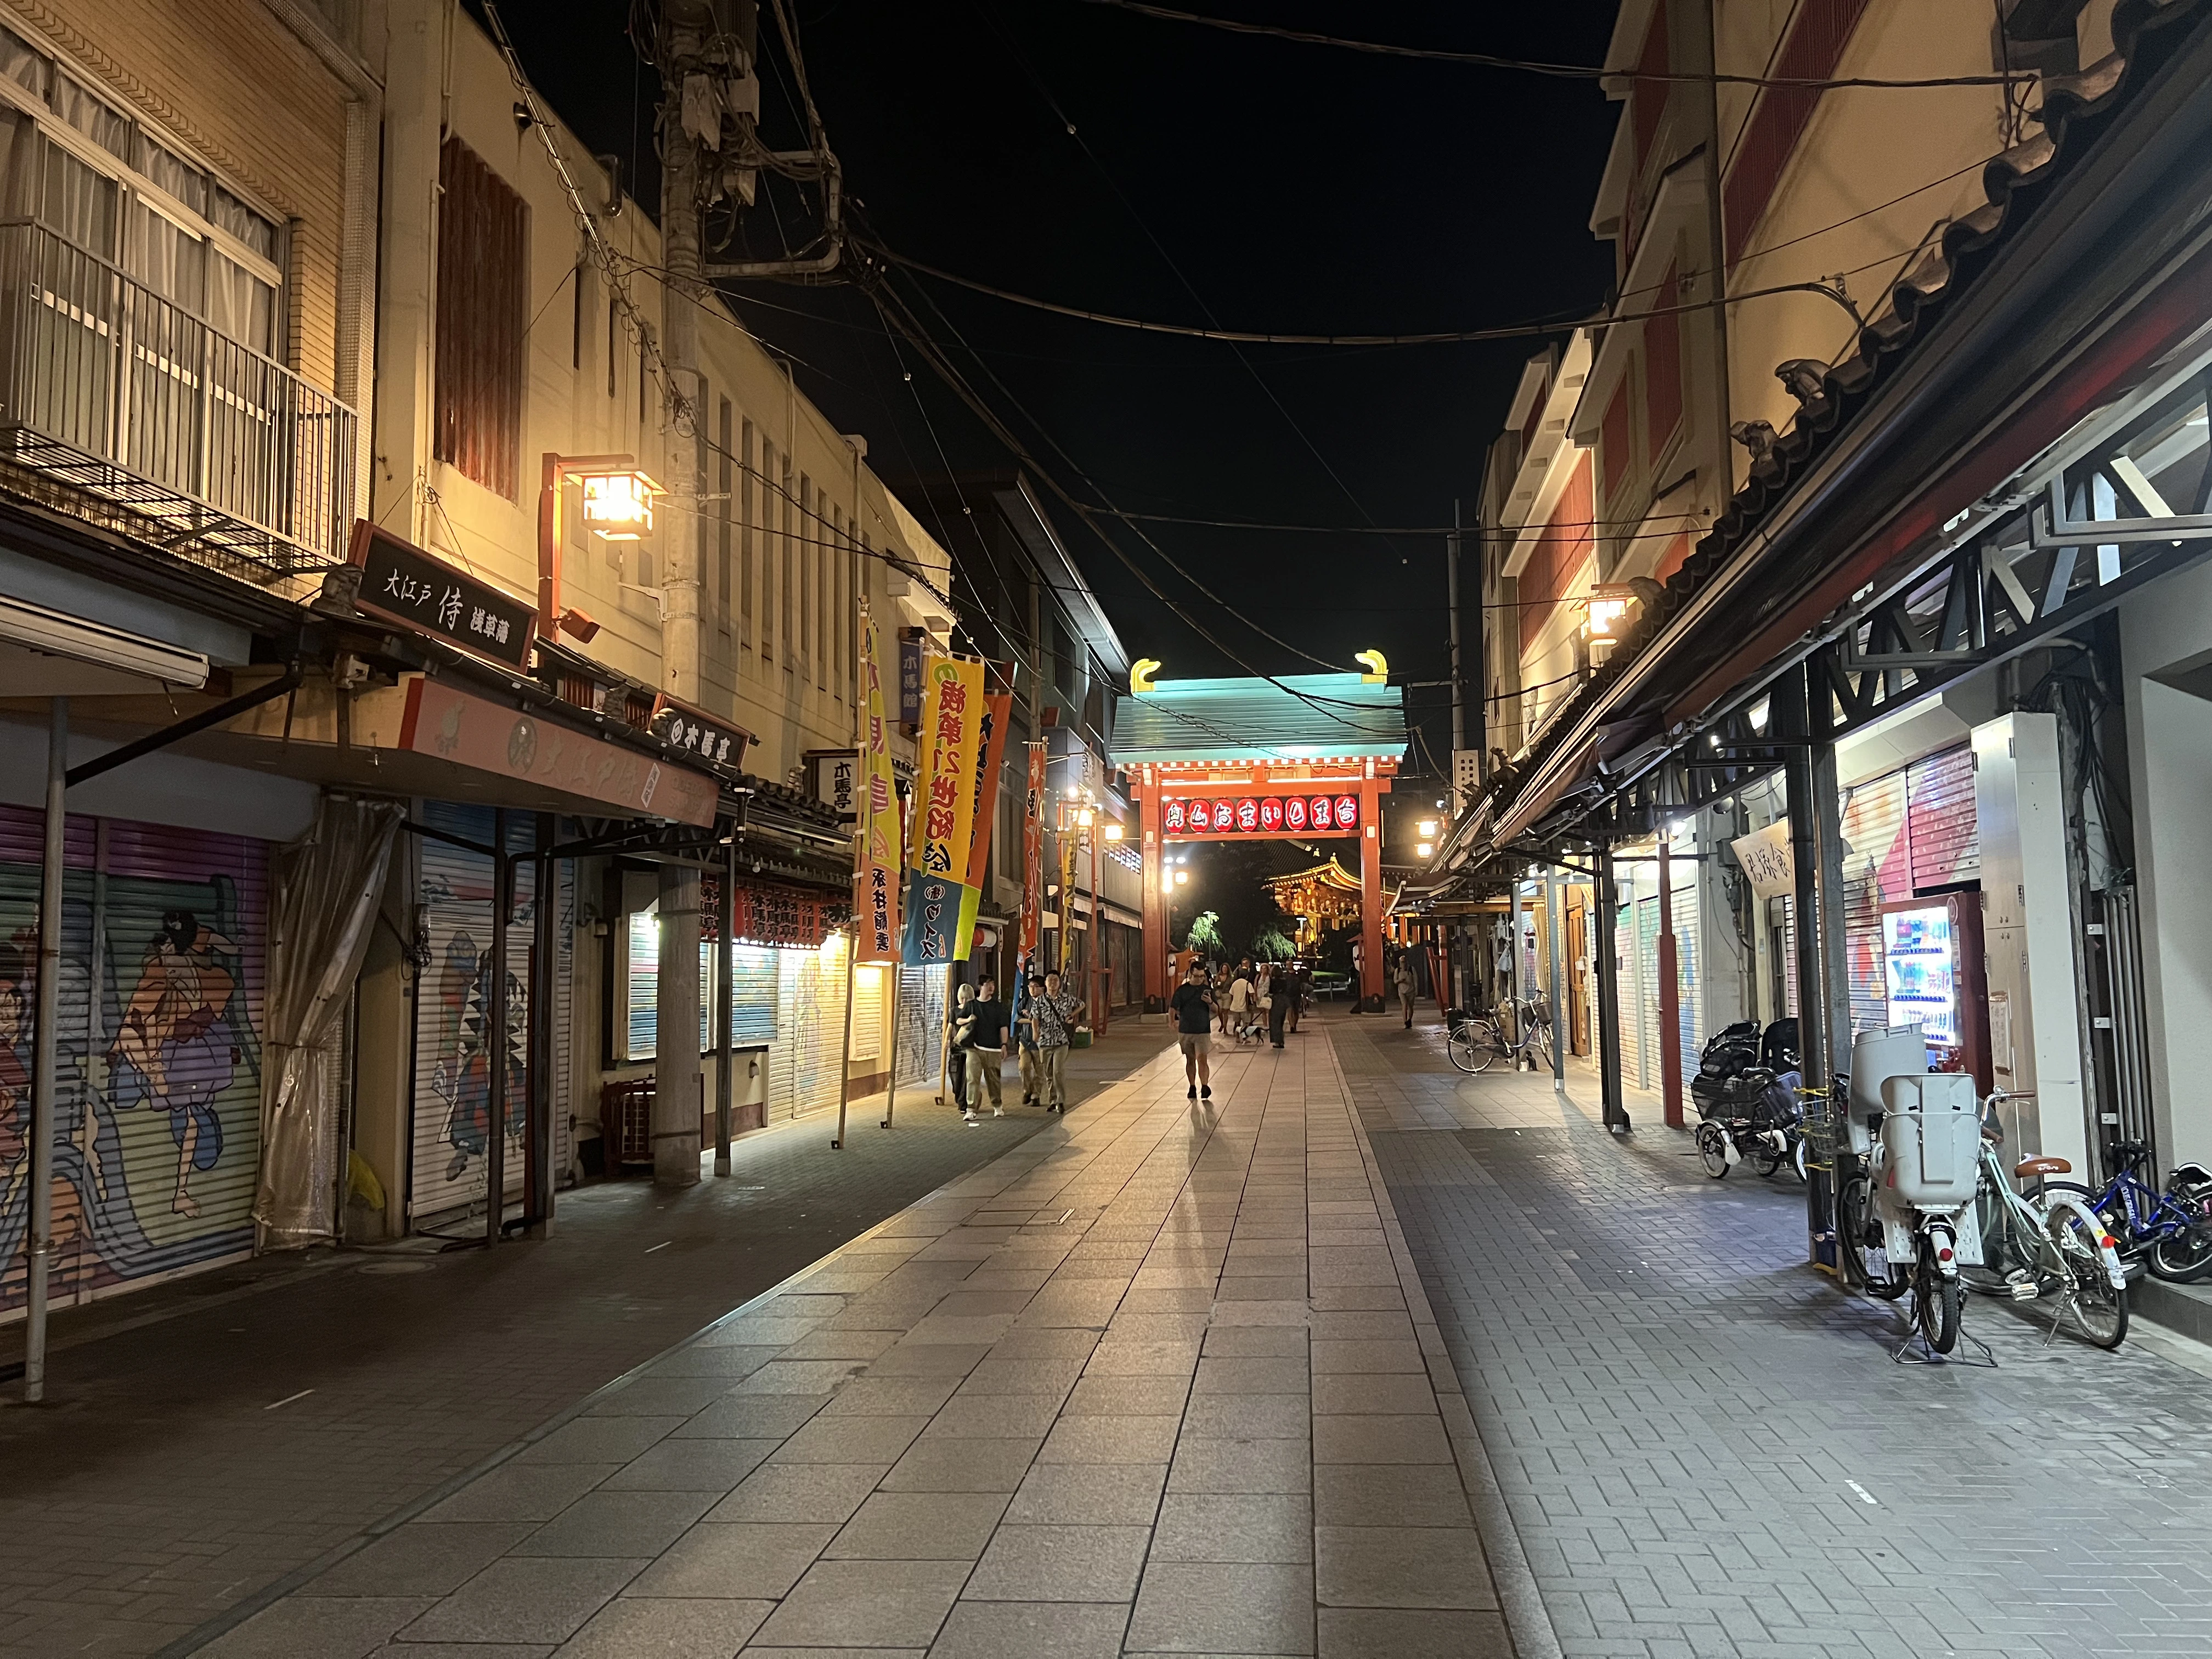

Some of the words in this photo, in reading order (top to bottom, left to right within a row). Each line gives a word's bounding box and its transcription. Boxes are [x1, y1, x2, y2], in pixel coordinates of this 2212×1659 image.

[383, 567, 432, 607] 大江戸
[438, 585, 464, 631] 侍
[902, 655, 918, 708] 木馬館
[684, 723, 731, 764] 木馬亭
[833, 761, 852, 809] 木馬亭
